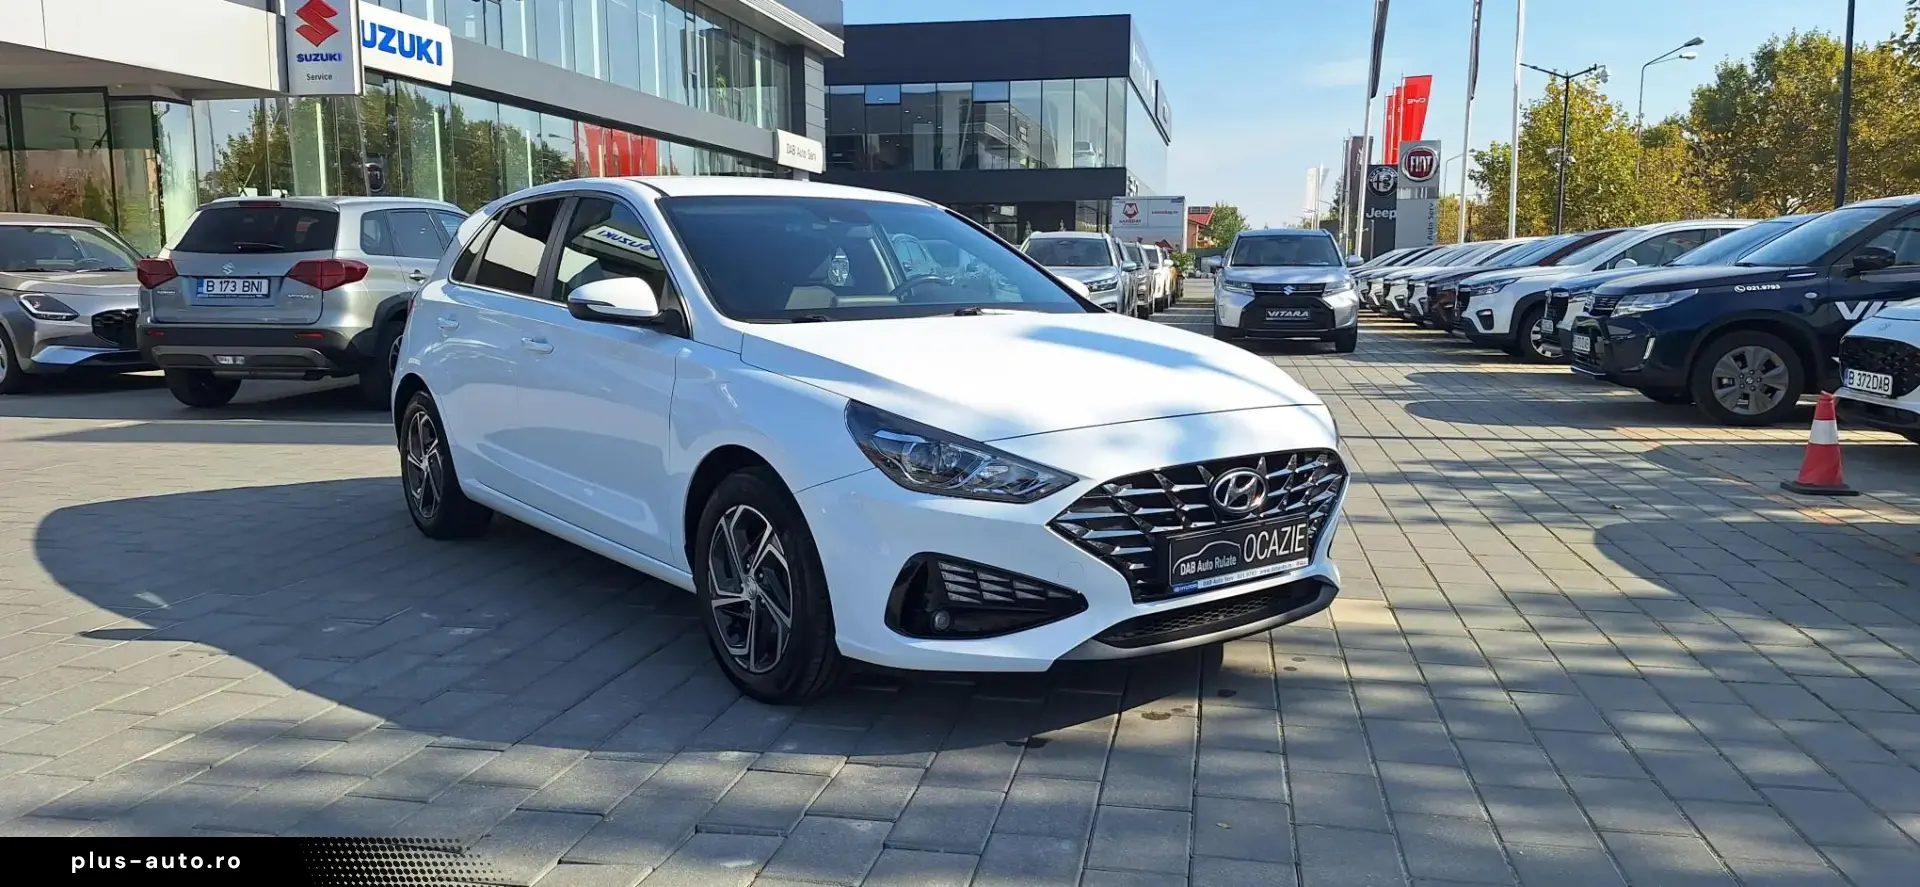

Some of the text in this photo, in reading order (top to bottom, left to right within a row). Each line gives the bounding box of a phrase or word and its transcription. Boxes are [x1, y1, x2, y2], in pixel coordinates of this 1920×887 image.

[361, 19, 443, 66] UZUKI
[296, 52, 342, 62] SUZUKI
[306, 73, 333, 81] Service
[1410, 155, 1433, 173] FIAT
[1365, 207, 1397, 220] Jeep
[206, 280, 262, 292] B 173 BNI
[1849, 370, 1890, 393] B 372DAB
[1244, 523, 1307, 562] OCAZIE
[1180, 554, 1237, 576] DAB Auto Rulate
